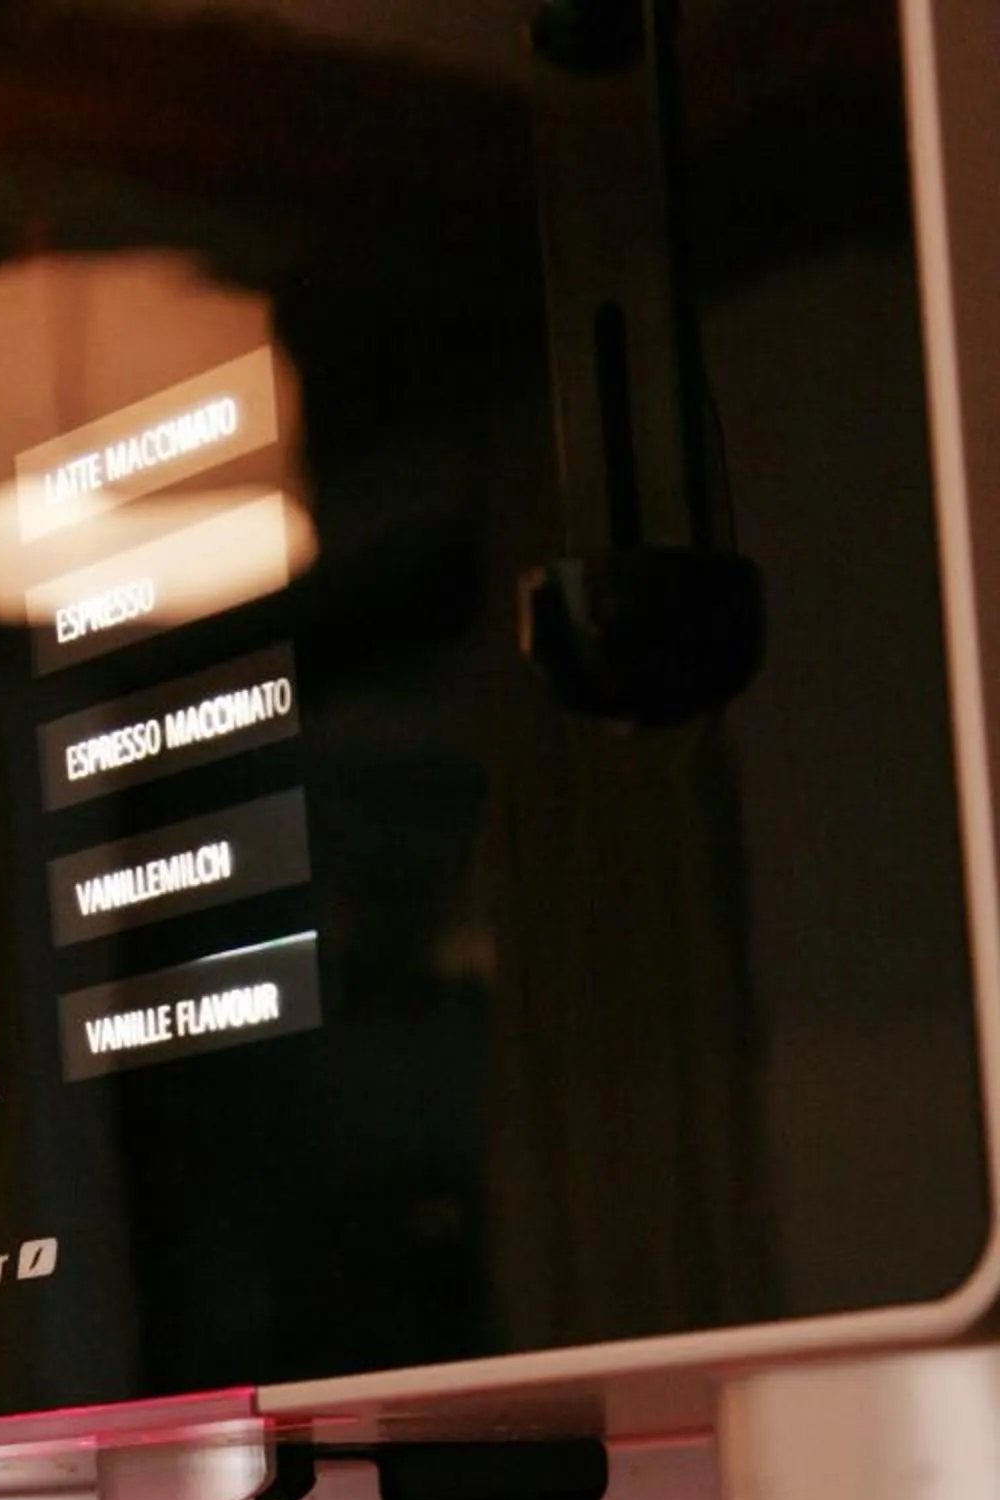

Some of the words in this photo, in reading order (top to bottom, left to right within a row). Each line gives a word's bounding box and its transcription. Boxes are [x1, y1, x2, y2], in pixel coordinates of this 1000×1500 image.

[44, 452, 104, 505] LATTE
[104, 396, 238, 482] MACCHIATO
[56, 577, 156, 644] ESPRESSO
[66, 719, 161, 781] ESPRESSO
[165, 678, 292, 750] MACCHIATO
[75, 840, 232, 917] VANILLEMILCH
[85, 1004, 173, 1055] VANILLE
[176, 981, 280, 1038] FLAVOUR
